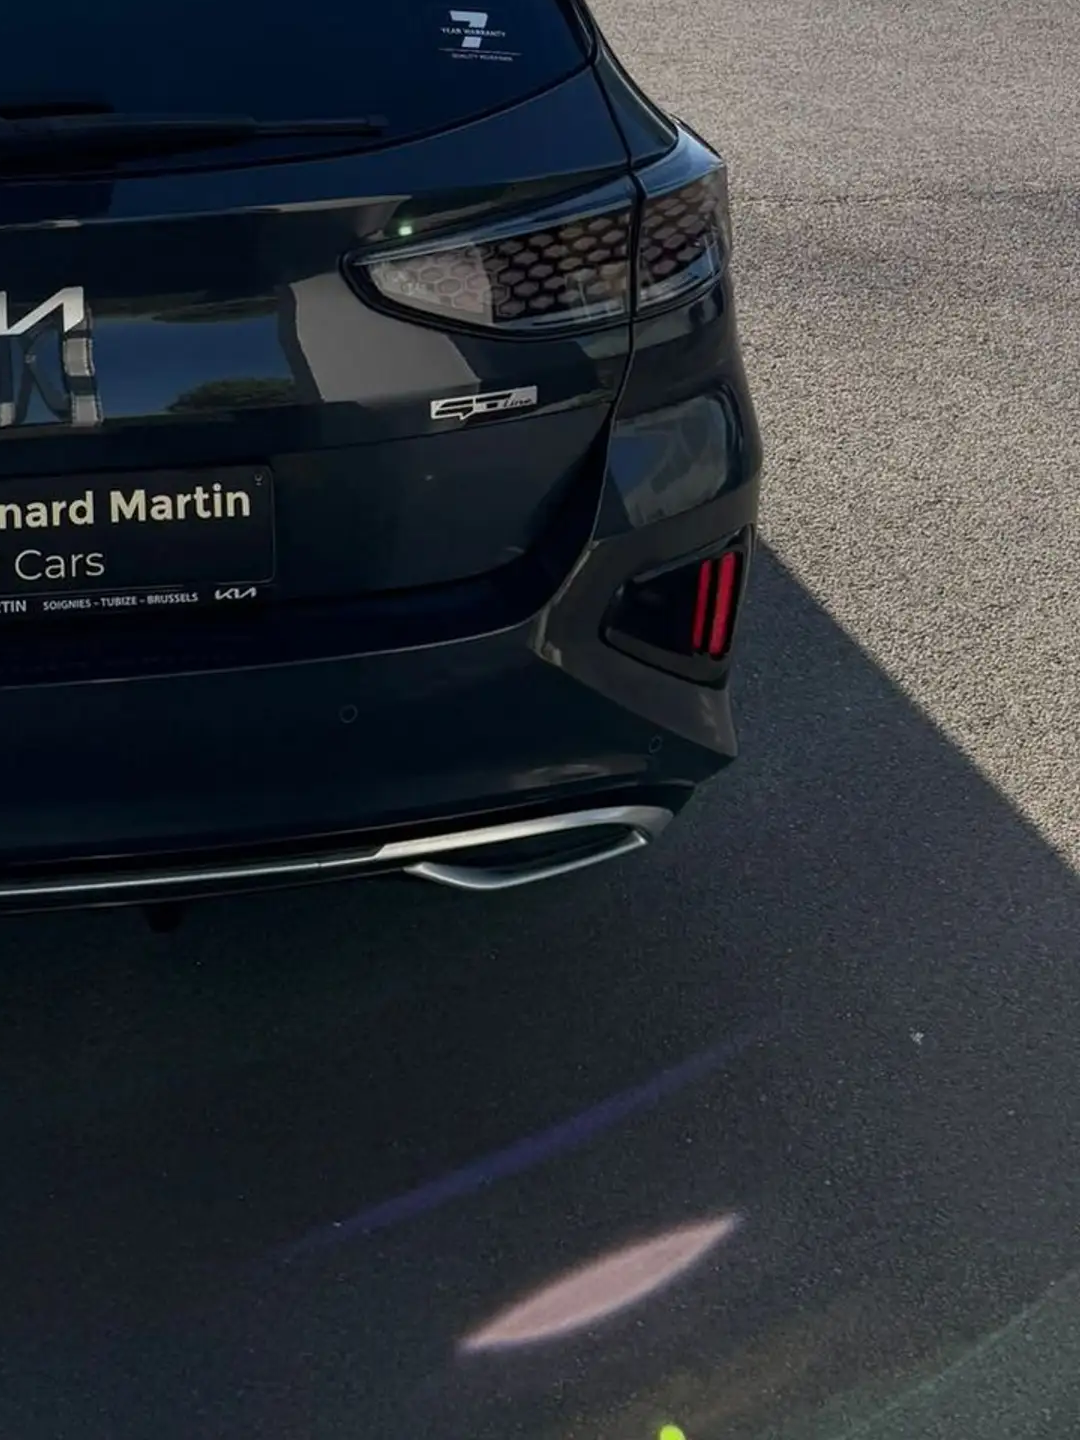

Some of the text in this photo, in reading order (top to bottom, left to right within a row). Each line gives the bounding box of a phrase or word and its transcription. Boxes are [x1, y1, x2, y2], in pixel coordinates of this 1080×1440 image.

[441, 27, 506, 38] YEAR WARRANTY
[110, 482, 252, 524] Martin
[14, 546, 106, 581] Cars
[43, 598, 92, 611] SOIGNIES
[100, 595, 138, 607] TUBIZE
[146, 592, 199, 605] BRUSSELS
[214, 587, 258, 601] KIA
